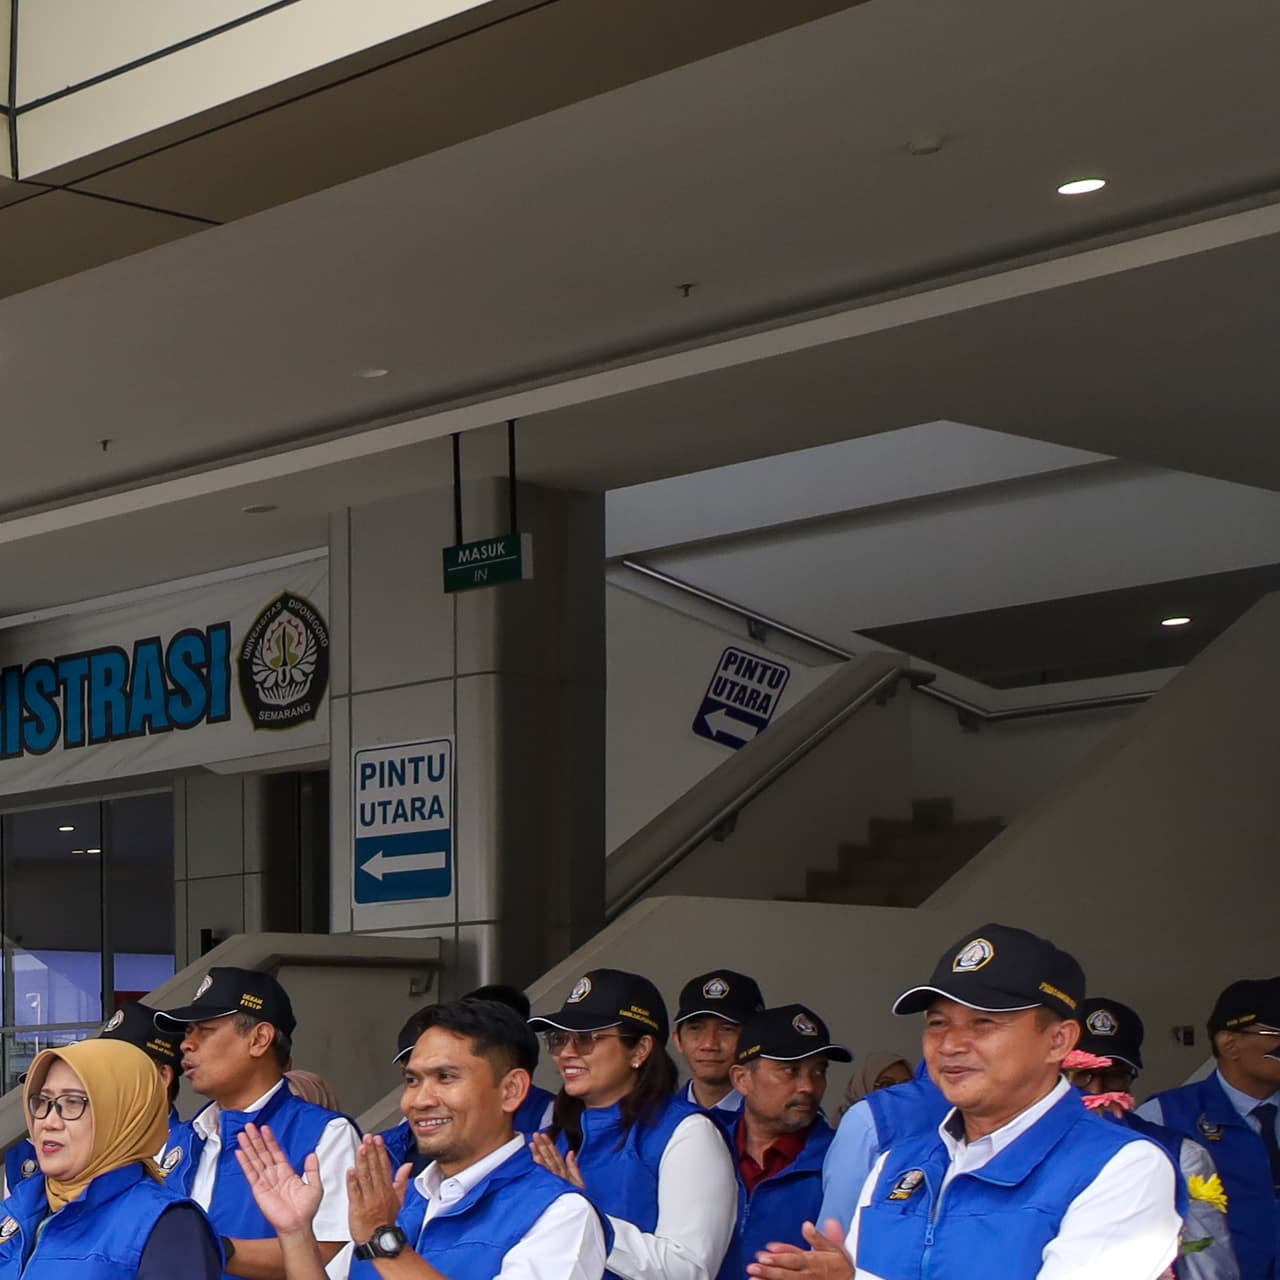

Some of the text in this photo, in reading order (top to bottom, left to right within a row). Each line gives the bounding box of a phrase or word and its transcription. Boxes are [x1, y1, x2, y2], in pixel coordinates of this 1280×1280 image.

[458, 542, 505, 563] MASUK
[473, 568, 488, 582] IN
[722, 651, 786, 689] PINTU
[258, 702, 311, 721] SEMARANG
[712, 676, 772, 715] UTARA
[360, 753, 446, 791] PINTU
[360, 795, 445, 827] UTARA
